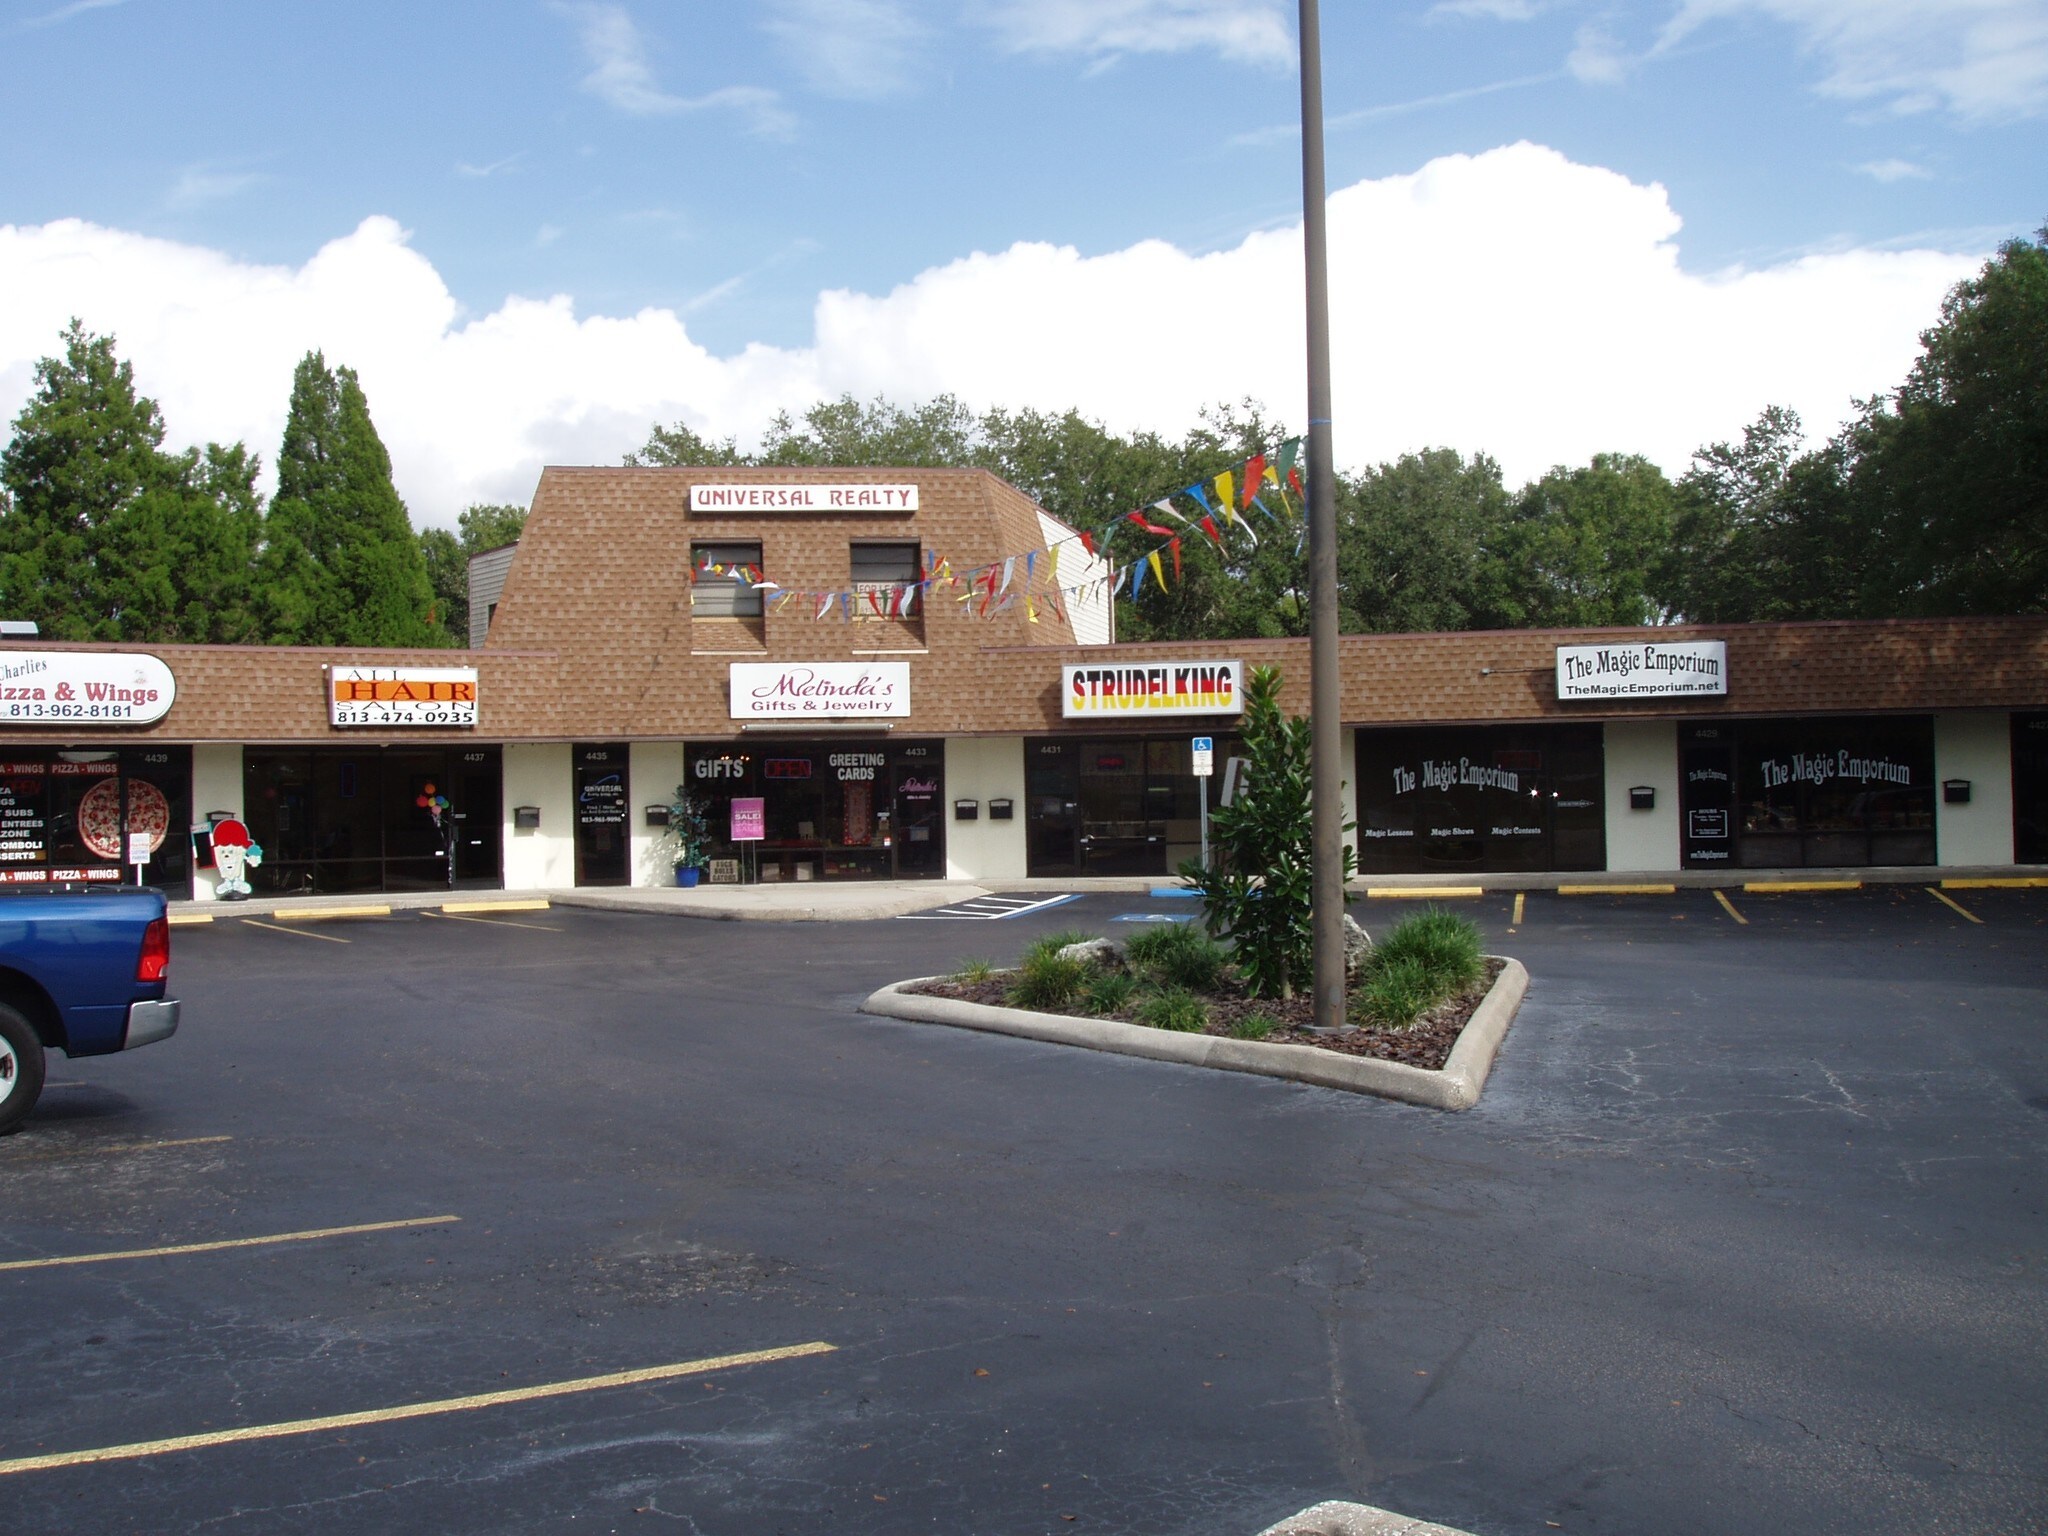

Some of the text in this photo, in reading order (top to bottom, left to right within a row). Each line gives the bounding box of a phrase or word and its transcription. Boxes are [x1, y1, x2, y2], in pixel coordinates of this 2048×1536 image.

[697, 490, 910, 506] UNIVERSAL REALTY
[1565, 646, 1719, 680] The Magic Emporium
[347, 670, 405, 681] ALL
[752, 668, 894, 697] Melinda's
[1565, 681, 1719, 695] TheMagicEmporium.net
[0, 682, 158, 706] zza & Wings
[347, 682, 475, 700] HAIR
[10, 704, 131, 717] 813-962-8181
[337, 701, 474, 711] SALON
[752, 700, 892, 712] Gifts & Jewelry
[338, 711, 473, 722] 813-474-0935
[905, 748, 927, 756] 4433
[1041, 745, 1061, 754] 4431
[145, 754, 168, 763] 4439
[464, 753, 484, 761] 4437
[585, 752, 607, 760] 4435
[829, 753, 885, 767] GREETING
[13, 764, 45, 773] WINGS
[52, 764, 79, 774] PIZZA
[86, 764, 118, 774] WINGS
[695, 759, 744, 778] GIFTS
[837, 767, 875, 780] CARDS
[1762, 749, 1910, 788] The Magic Emporium
[1393, 766, 1416, 794] The
[1422, 760, 1457, 791] Magic
[1459, 757, 1518, 792] Emporium
[5, 809, 34, 818] SUBS
[2, 819, 44, 828] ENTREES
[0, 830, 31, 839] ZONE
[1365, 829, 1386, 838] Magic
[1431, 827, 1474, 836] Magic Shows
[1491, 826, 1541, 835] Magic Contests
[13, 870, 46, 881] WINGS
[53, 870, 81, 880] PIZZA
[88, 869, 119, 879] WINGS
